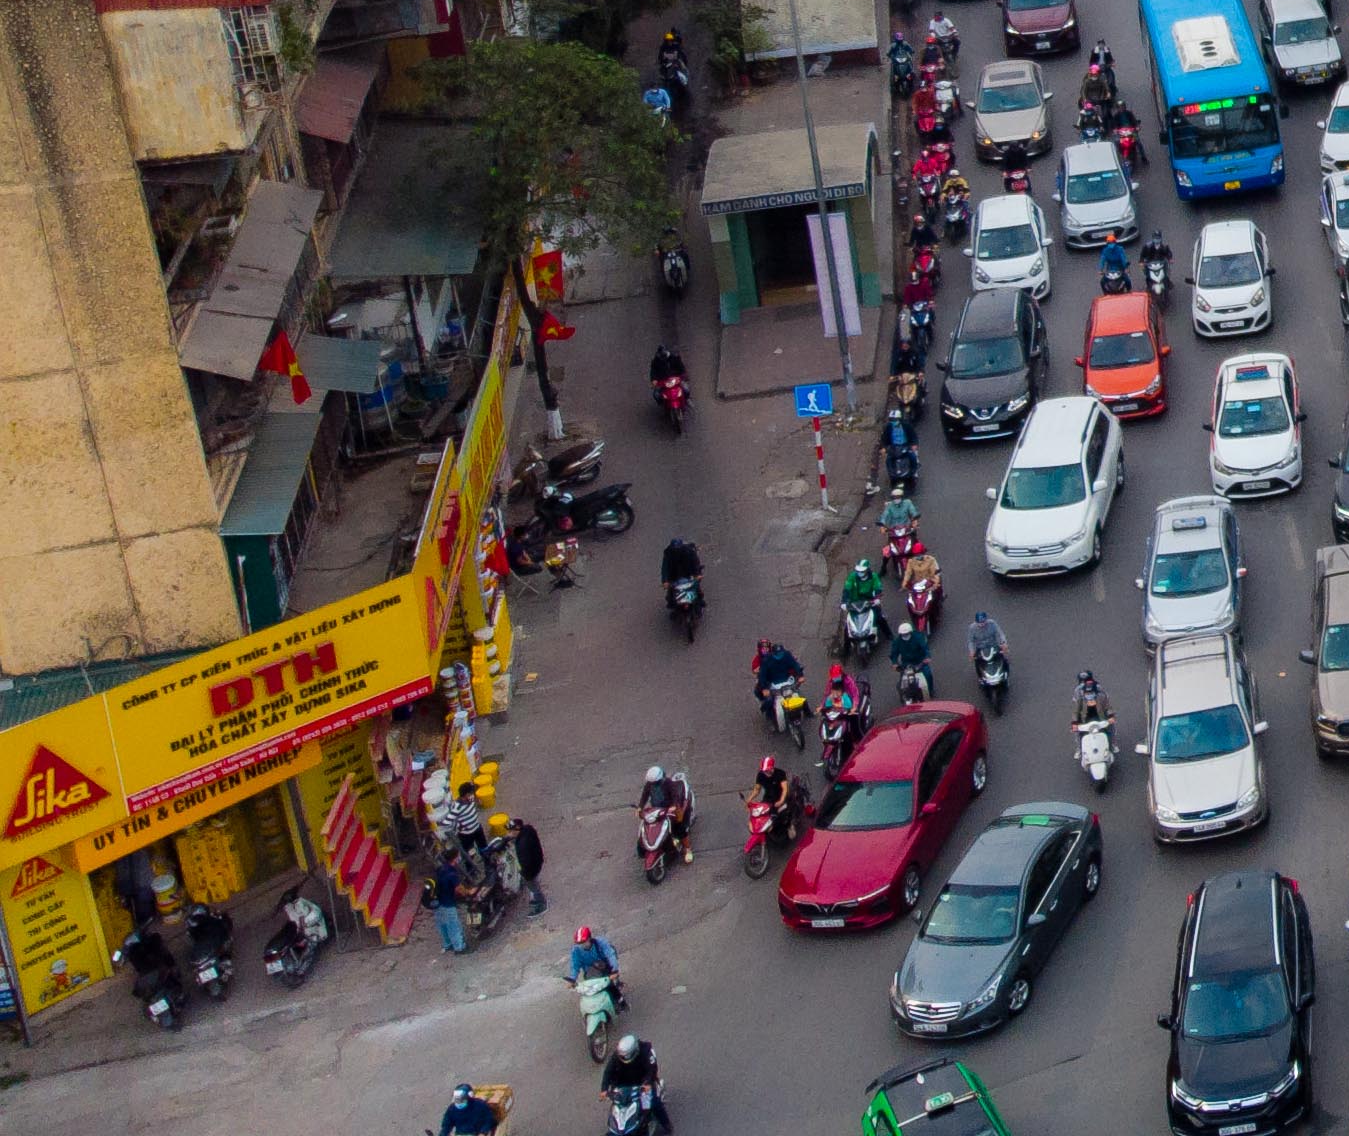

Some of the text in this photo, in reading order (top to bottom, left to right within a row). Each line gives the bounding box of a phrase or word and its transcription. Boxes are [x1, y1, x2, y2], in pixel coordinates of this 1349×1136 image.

[122, 690, 159, 711] CÔNG
[161, 682, 177, 695] TY
[180, 675, 198, 688] CP
[201, 661, 231, 680] KIẾN
[236, 646, 268, 665] TRÚC
[285, 631, 307, 646] VẬT
[311, 619, 337, 637] LIỆU
[342, 608, 365, 625] XÂY
[369, 594, 401, 615] DỰNG
[208, 641, 338, 719] DTH
[170, 660, 379, 753] ĐẠI LÝ PHÂN PHỐI CHÍNH THỨC
[221, 723, 257, 745] CHẤT
[260, 711, 287, 731] XÂY
[295, 692, 331, 716] DỰNG
[336, 679, 367, 699] SIKA
[13, 767, 91, 827] Sika
[94, 829, 115, 851] UY
[121, 814, 150, 839] TÍN
[157, 805, 169, 821] &
